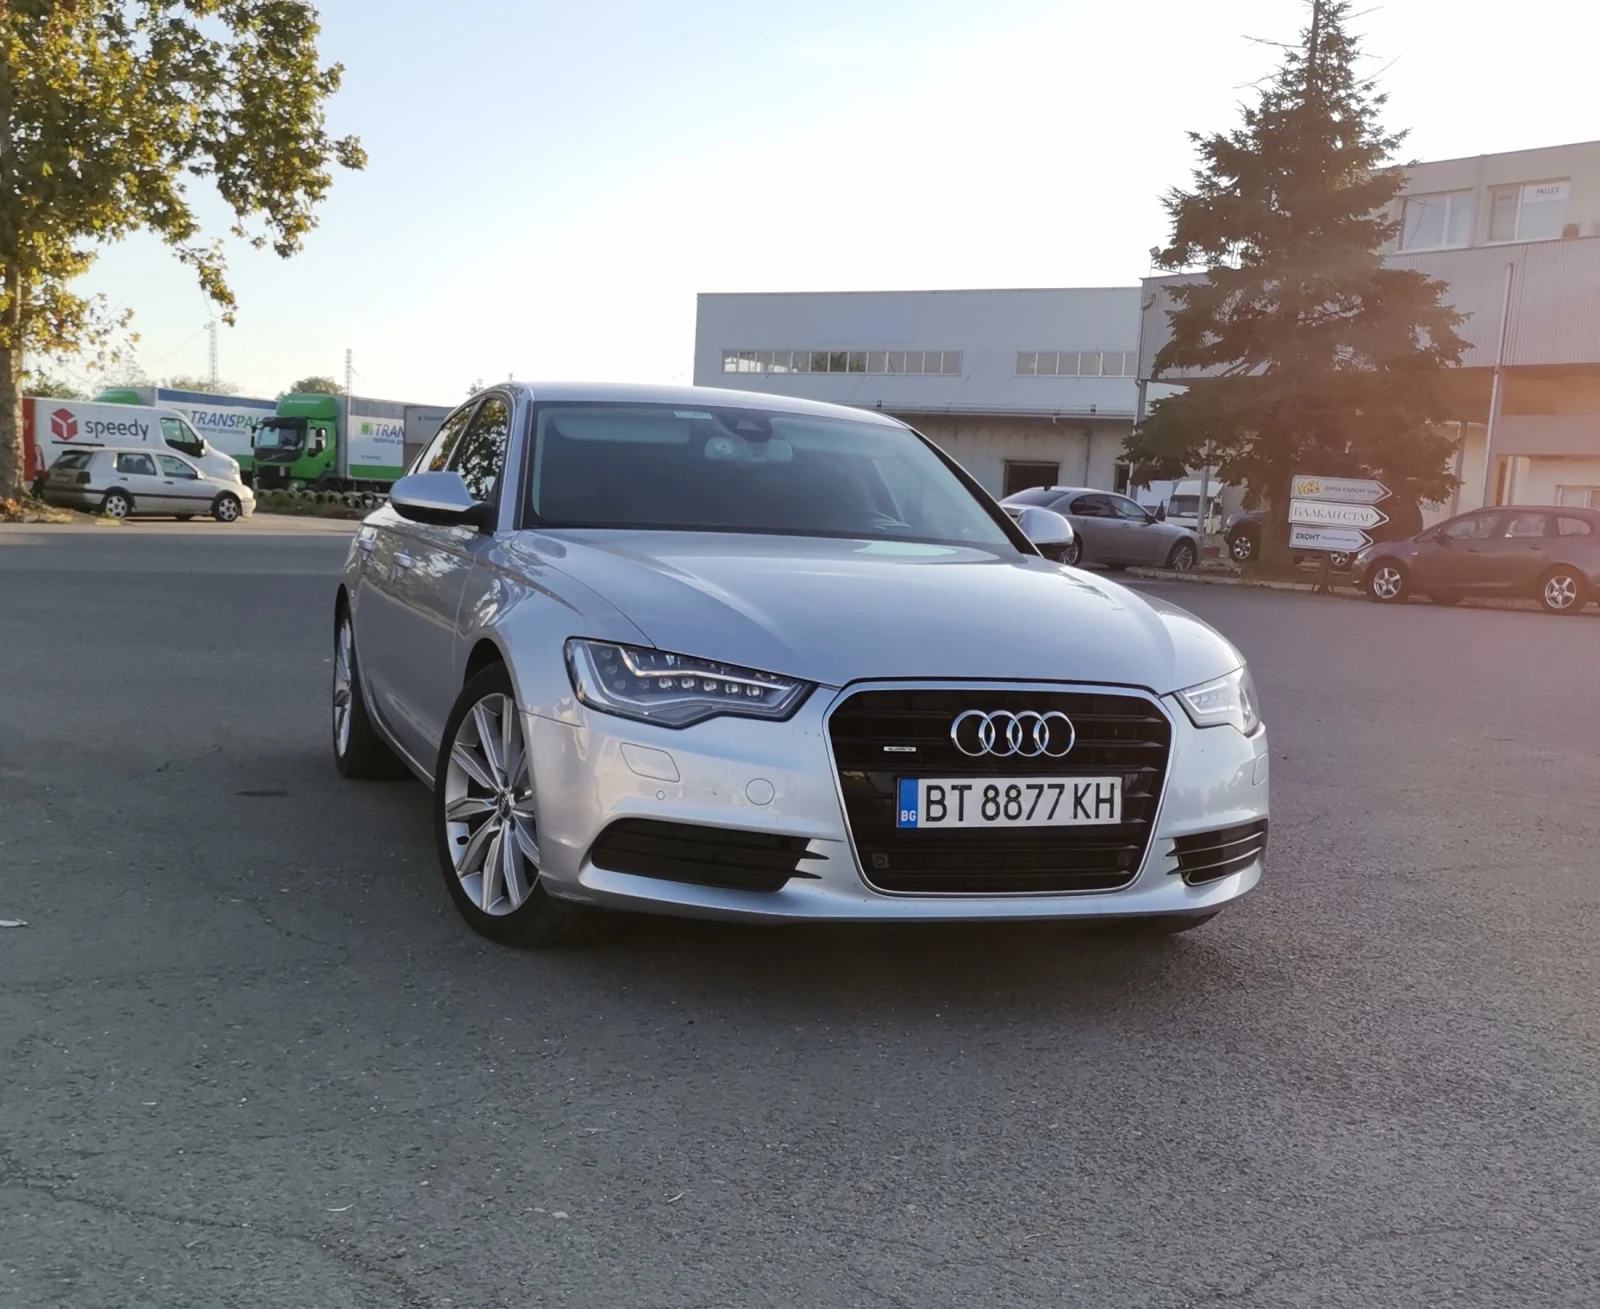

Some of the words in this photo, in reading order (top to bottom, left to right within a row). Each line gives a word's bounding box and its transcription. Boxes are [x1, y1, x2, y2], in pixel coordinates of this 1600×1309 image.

[85, 419, 149, 441] speedy
[1343, 510, 1374, 522] СТАР
[1296, 532, 1321, 541] ЕКОНТ
[925, 784, 973, 822] BT
[981, 783, 1066, 822] 8877
[1072, 782, 1116, 820] KH
[901, 810, 917, 822] BG
